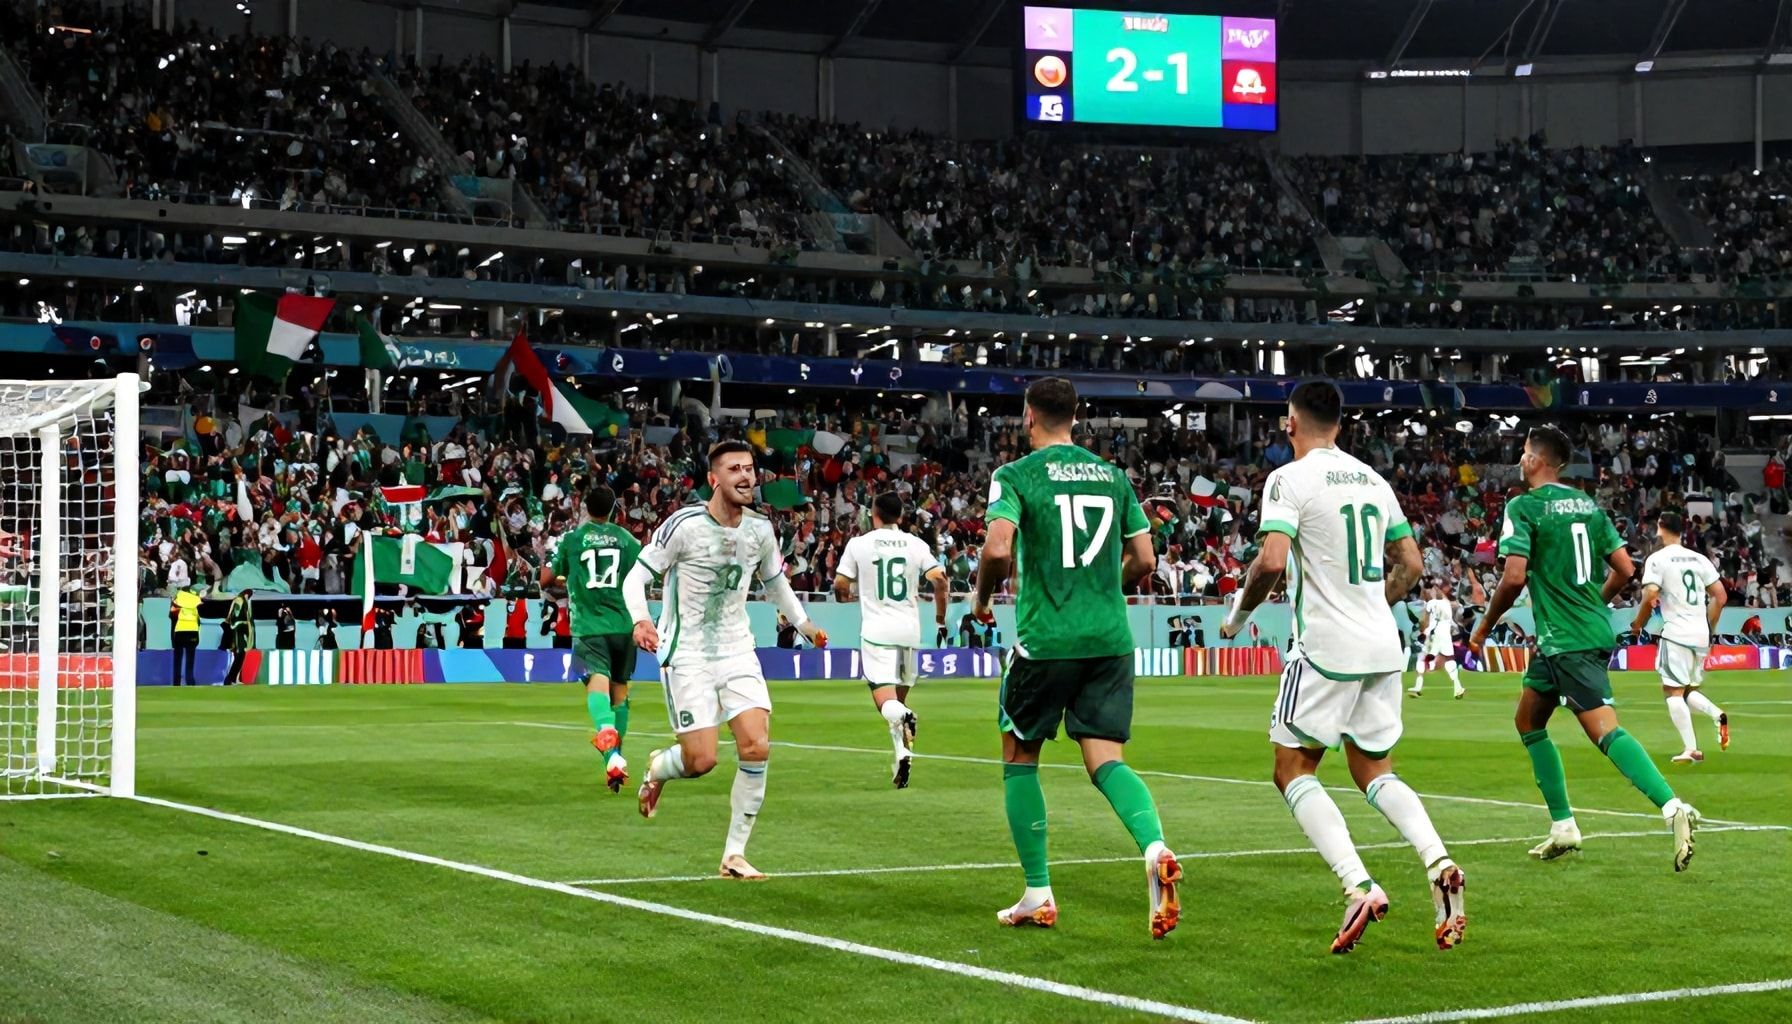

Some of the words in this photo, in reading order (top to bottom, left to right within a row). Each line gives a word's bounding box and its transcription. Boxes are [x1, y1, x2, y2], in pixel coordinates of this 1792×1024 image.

[1106, 47, 1189, 95] 2-1
[1054, 494, 1114, 569] 17
[1340, 503, 1384, 585] 10
[872, 557, 907, 602] 16
